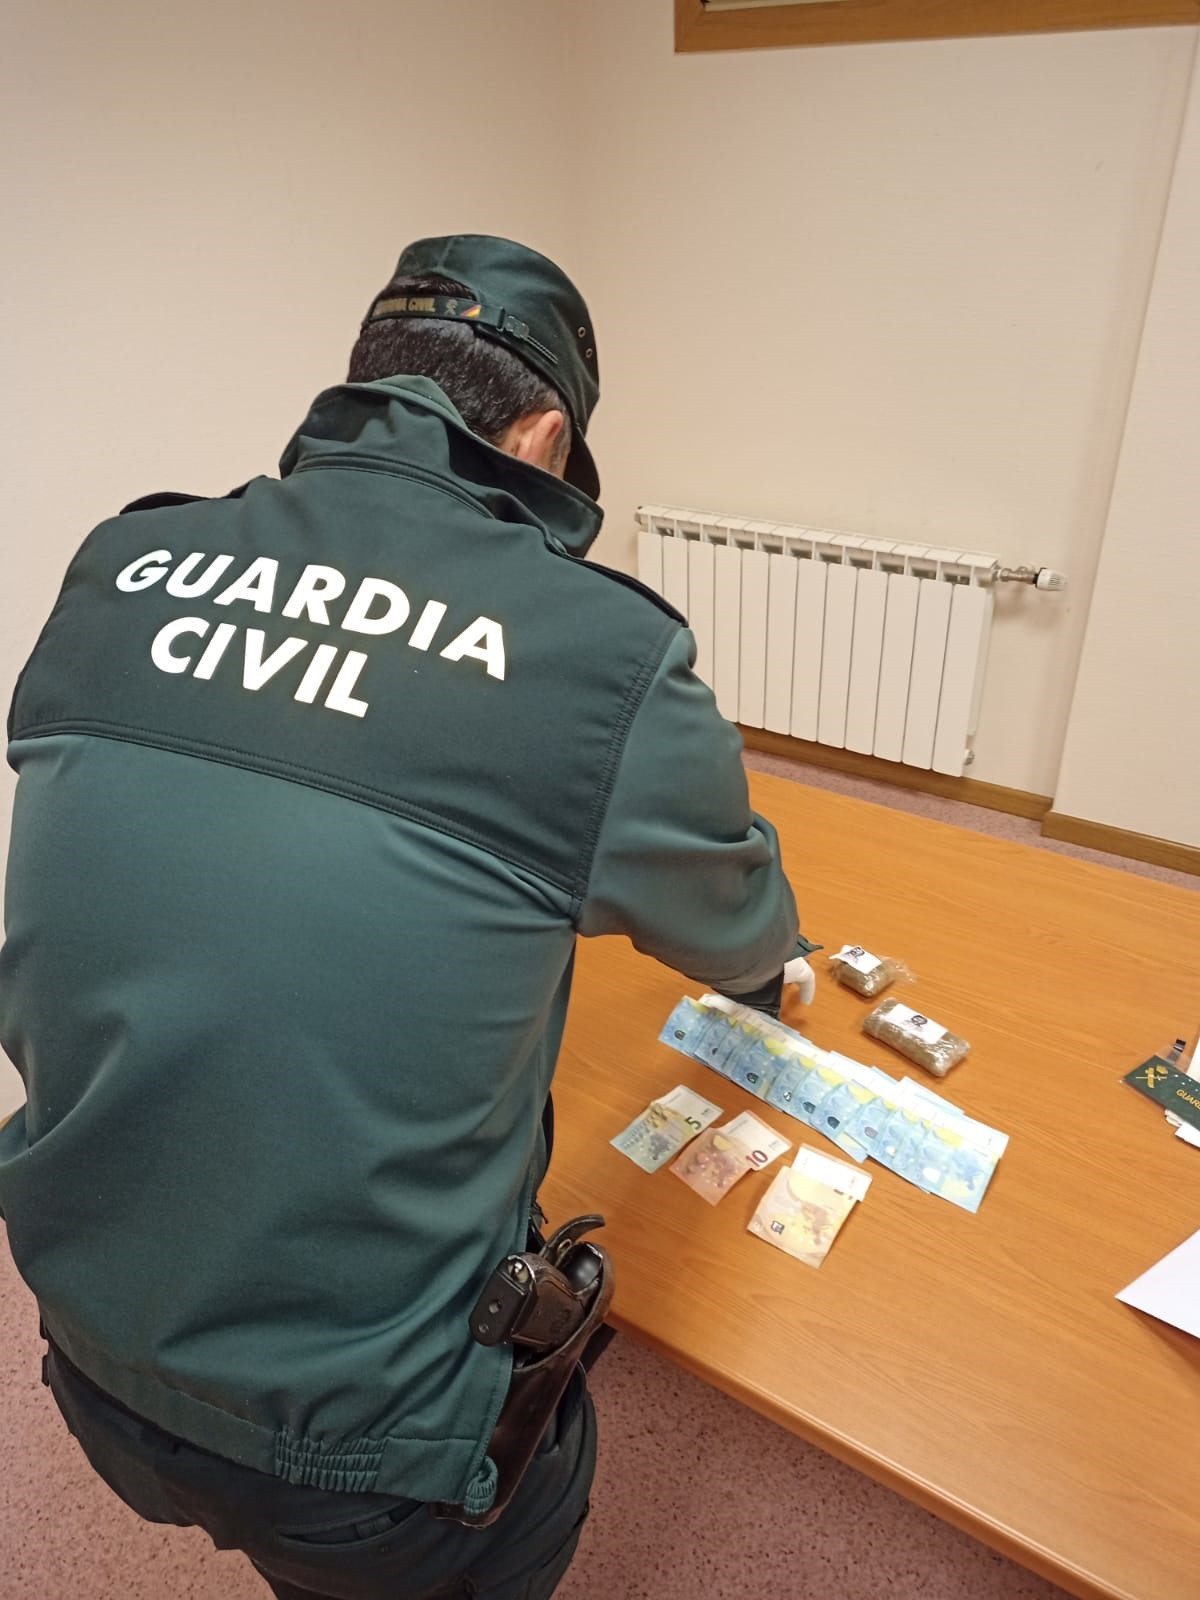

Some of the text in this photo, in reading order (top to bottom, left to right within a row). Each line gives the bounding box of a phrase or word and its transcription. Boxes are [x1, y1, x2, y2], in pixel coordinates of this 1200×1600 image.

[115, 549, 506, 681] GUARDIA
[150, 616, 369, 718] CIVIL
[684, 1116, 702, 1130] 5
[745, 1150, 768, 1167] 10
